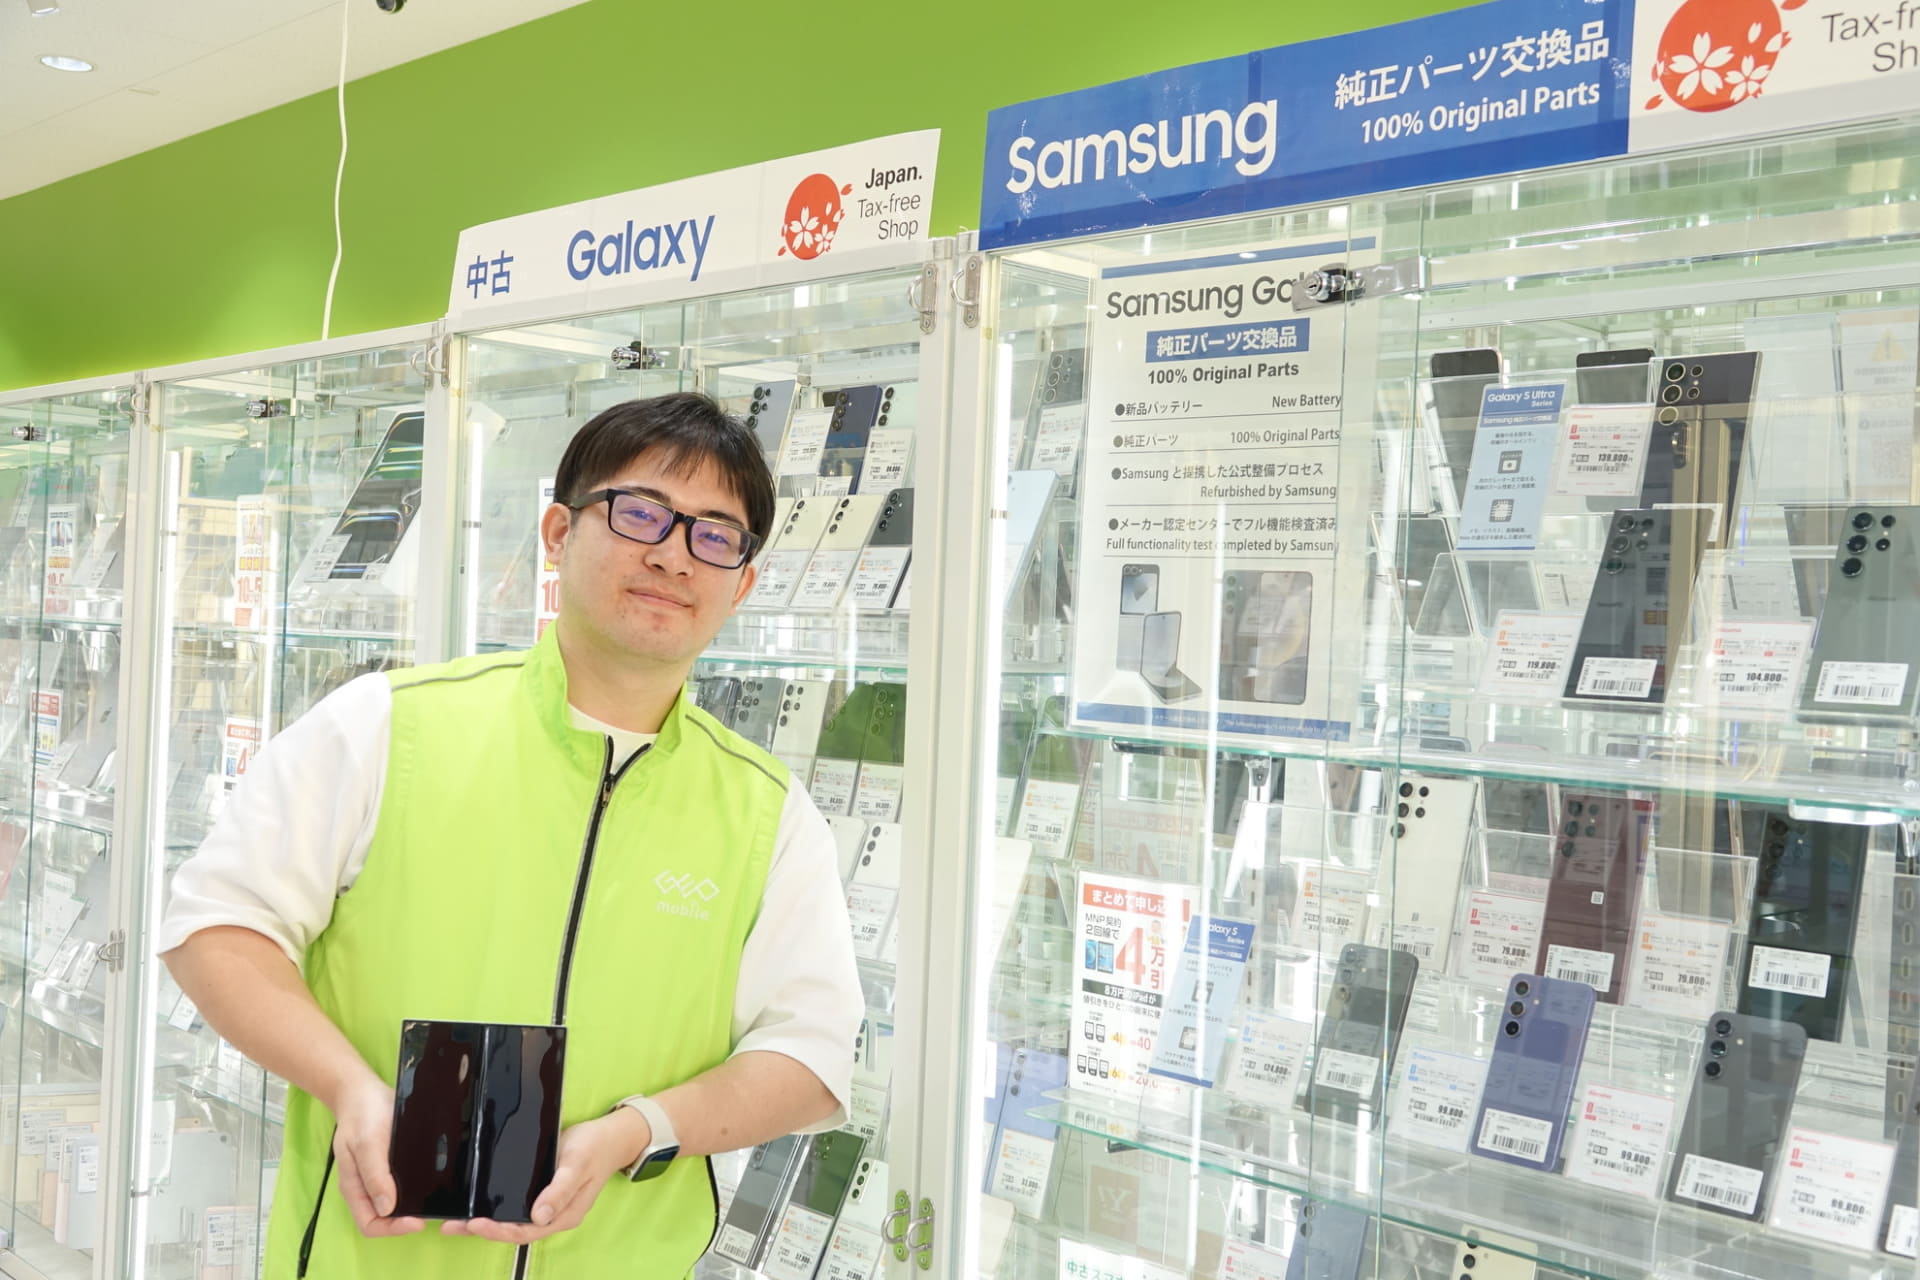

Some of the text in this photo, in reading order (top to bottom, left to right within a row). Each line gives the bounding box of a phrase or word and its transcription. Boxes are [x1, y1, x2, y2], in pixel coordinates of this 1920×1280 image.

[1821, 0, 1920, 42] Tax-fr
[1334, 19, 1609, 110] 純正パーツ交換品
[1872, 40, 1918, 72] Sh
[1361, 82, 1600, 145] 100% Original Parts
[1006, 98, 1278, 194] Samsung
[864, 163, 923, 190] Japan.
[857, 191, 922, 220] Tax-free
[877, 218, 919, 243] Shop
[566, 214, 715, 282] Galaxy
[466, 249, 514, 300] 中古
[1106, 283, 1243, 319] Samsung
[1156, 325, 1298, 358] 純正パーツ交換品
[1148, 362, 1300, 385] 100% Original Parts
[1125, 400, 1204, 417] 新品バッテリー
[1272, 393, 1342, 408] New Battery
[1487, 389, 1556, 403] Galaxy S Ultra
[1123, 433, 1179, 448] 純正パーツ
[1230, 428, 1340, 444] 100% Original Parts
[1122, 467, 1169, 481] Samsung
[1200, 484, 1337, 499] Refurbished by Samsung
[1106, 538, 1125, 550] Full
[1127, 537, 1191, 552] functionality
[1193, 539, 1213, 550] test
[1274, 538, 1288, 553] by
[1208, 923, 1232, 936] alaxy
